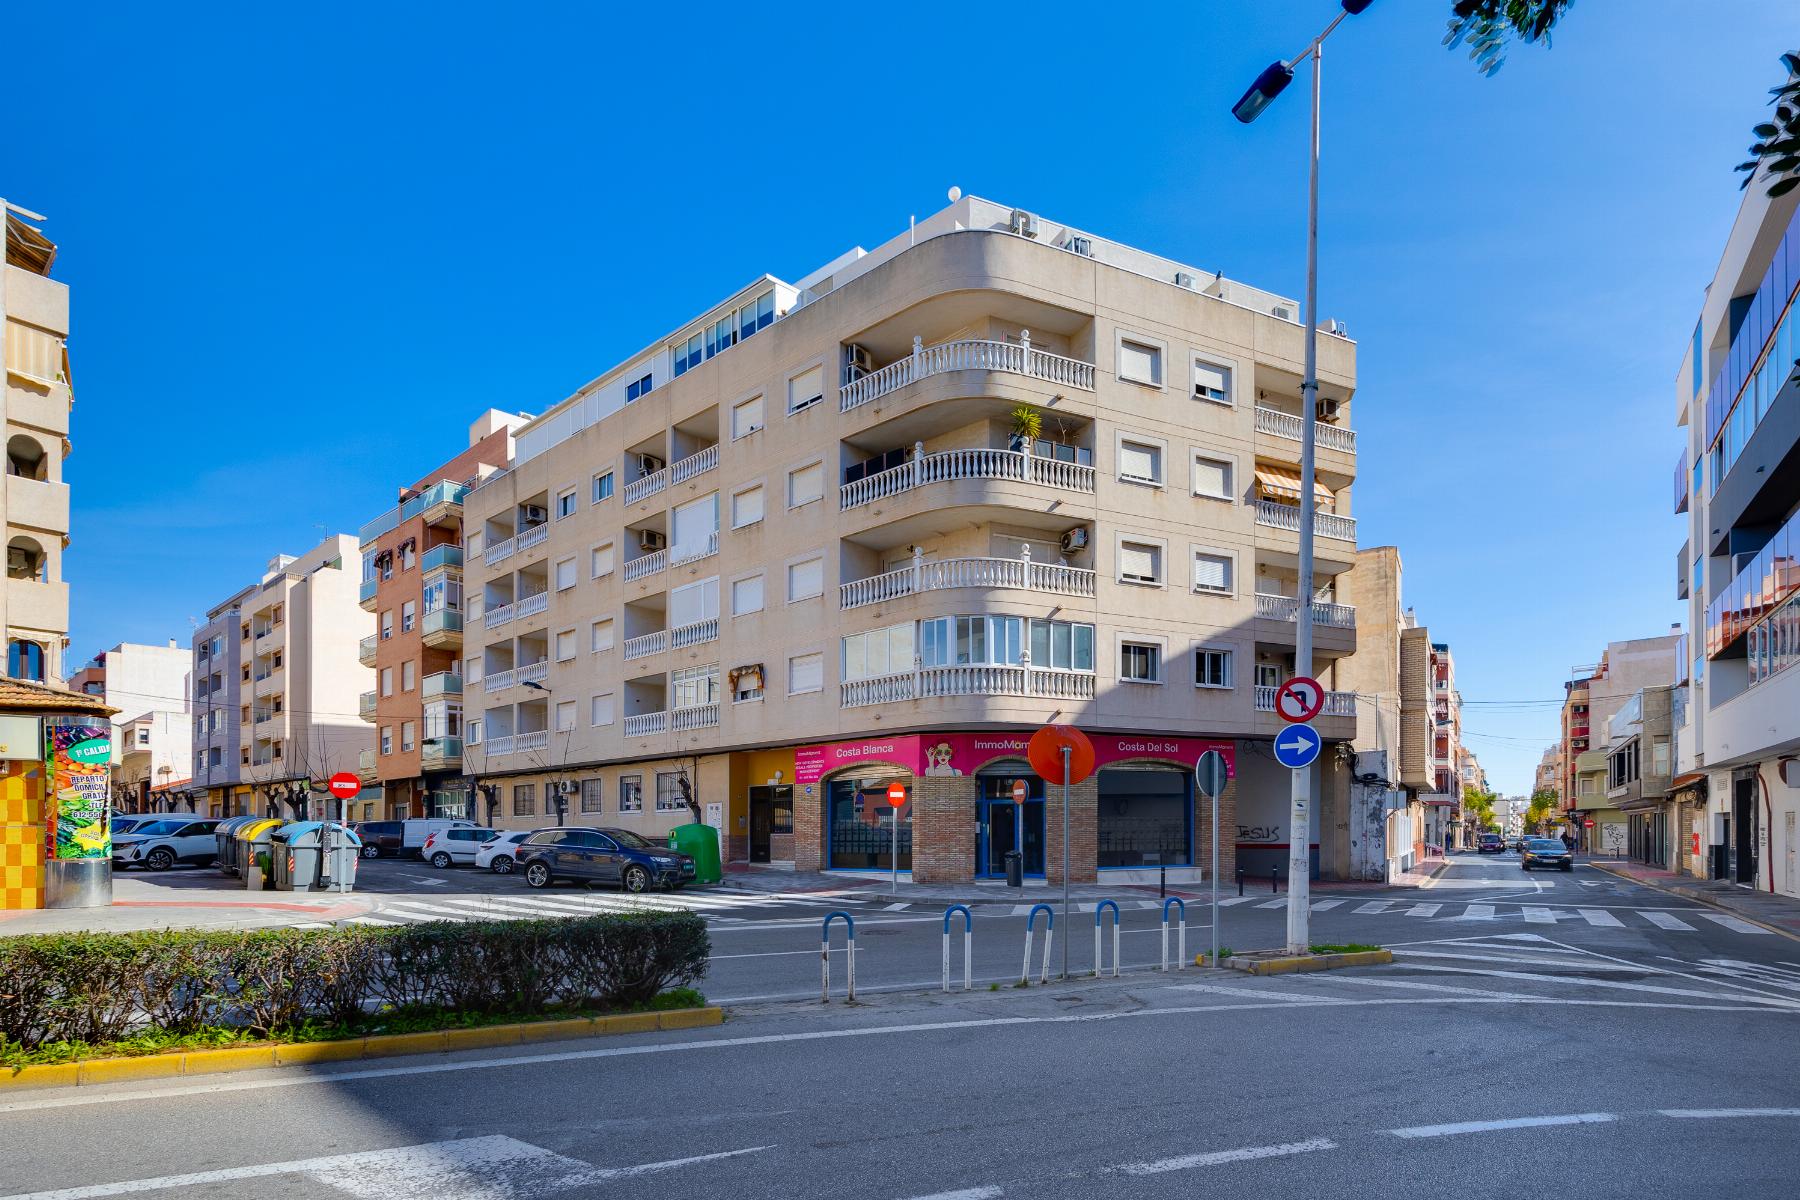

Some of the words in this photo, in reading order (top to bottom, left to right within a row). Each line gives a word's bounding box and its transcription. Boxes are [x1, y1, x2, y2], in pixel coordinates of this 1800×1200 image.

[974, 740, 1031, 749] ImmoMom
[1118, 741, 1145, 752] Costa
[1147, 742, 1162, 752] Del
[1164, 743, 1178, 753] Sol
[836, 747, 861, 758] Costa
[863, 745, 894, 755] Blanca
[71, 775, 105, 784] REPARTO
[82, 792, 106, 800] GRATI
